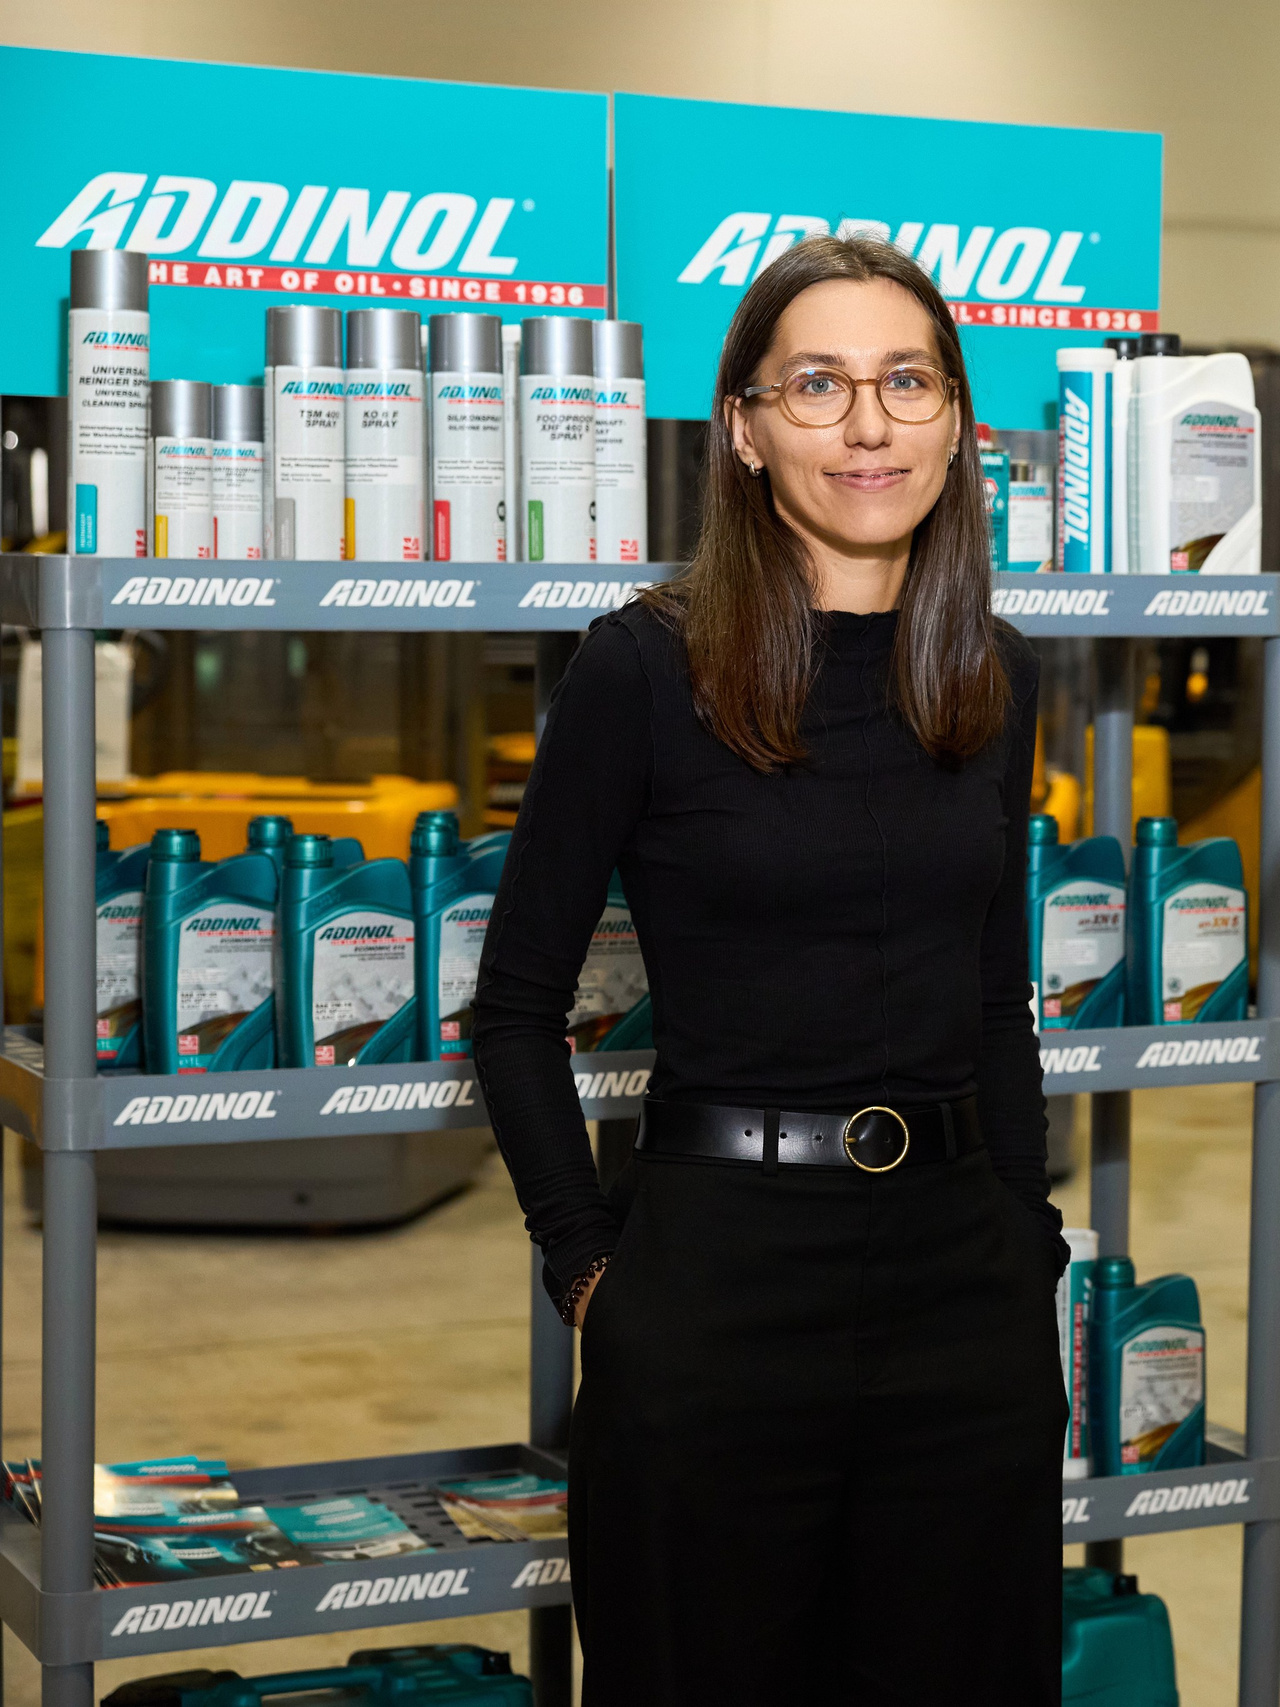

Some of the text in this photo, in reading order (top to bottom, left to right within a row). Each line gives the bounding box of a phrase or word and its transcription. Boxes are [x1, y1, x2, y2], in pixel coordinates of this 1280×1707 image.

[35, 171, 519, 275] ADDINOL
[149, 262, 189, 285] HE
[203, 265, 264, 288] ART
[280, 270, 319, 292] OF
[514, 284, 584, 306] 1936
[1081, 310, 1143, 331] 1936
[82, 331, 149, 347] ADDINOL
[92, 366, 147, 377] UNIVERSAL
[132, 378, 150, 388] SPR
[281, 381, 345, 396] ADDINOL
[345, 382, 411, 396] ADDINOL
[437, 385, 502, 400] ADDINOL
[530, 386, 595, 401] ADDINOL
[1064, 387, 1090, 545] ADDINOL
[111, 577, 276, 607] ADDINOL
[319, 579, 477, 608] ADDINOL
[517, 580, 656, 609] ADDIN
[1144, 589, 1270, 617] ADDINOL
[185, 917, 262, 932] ADDINOL
[318, 924, 396, 941] ADDINOL
[1038, 1045, 1102, 1075] INOL
[1135, 1036, 1262, 1069] ADDINOL
[320, 1080, 475, 1116] ADDINOL
[574, 1068, 651, 1100] DINO
[113, 1090, 277, 1126] ADDINOL
[1124, 1478, 1251, 1518] ADDINOL
[315, 1568, 471, 1613] ADDINOL
[110, 1591, 273, 1637] ADDINOL
